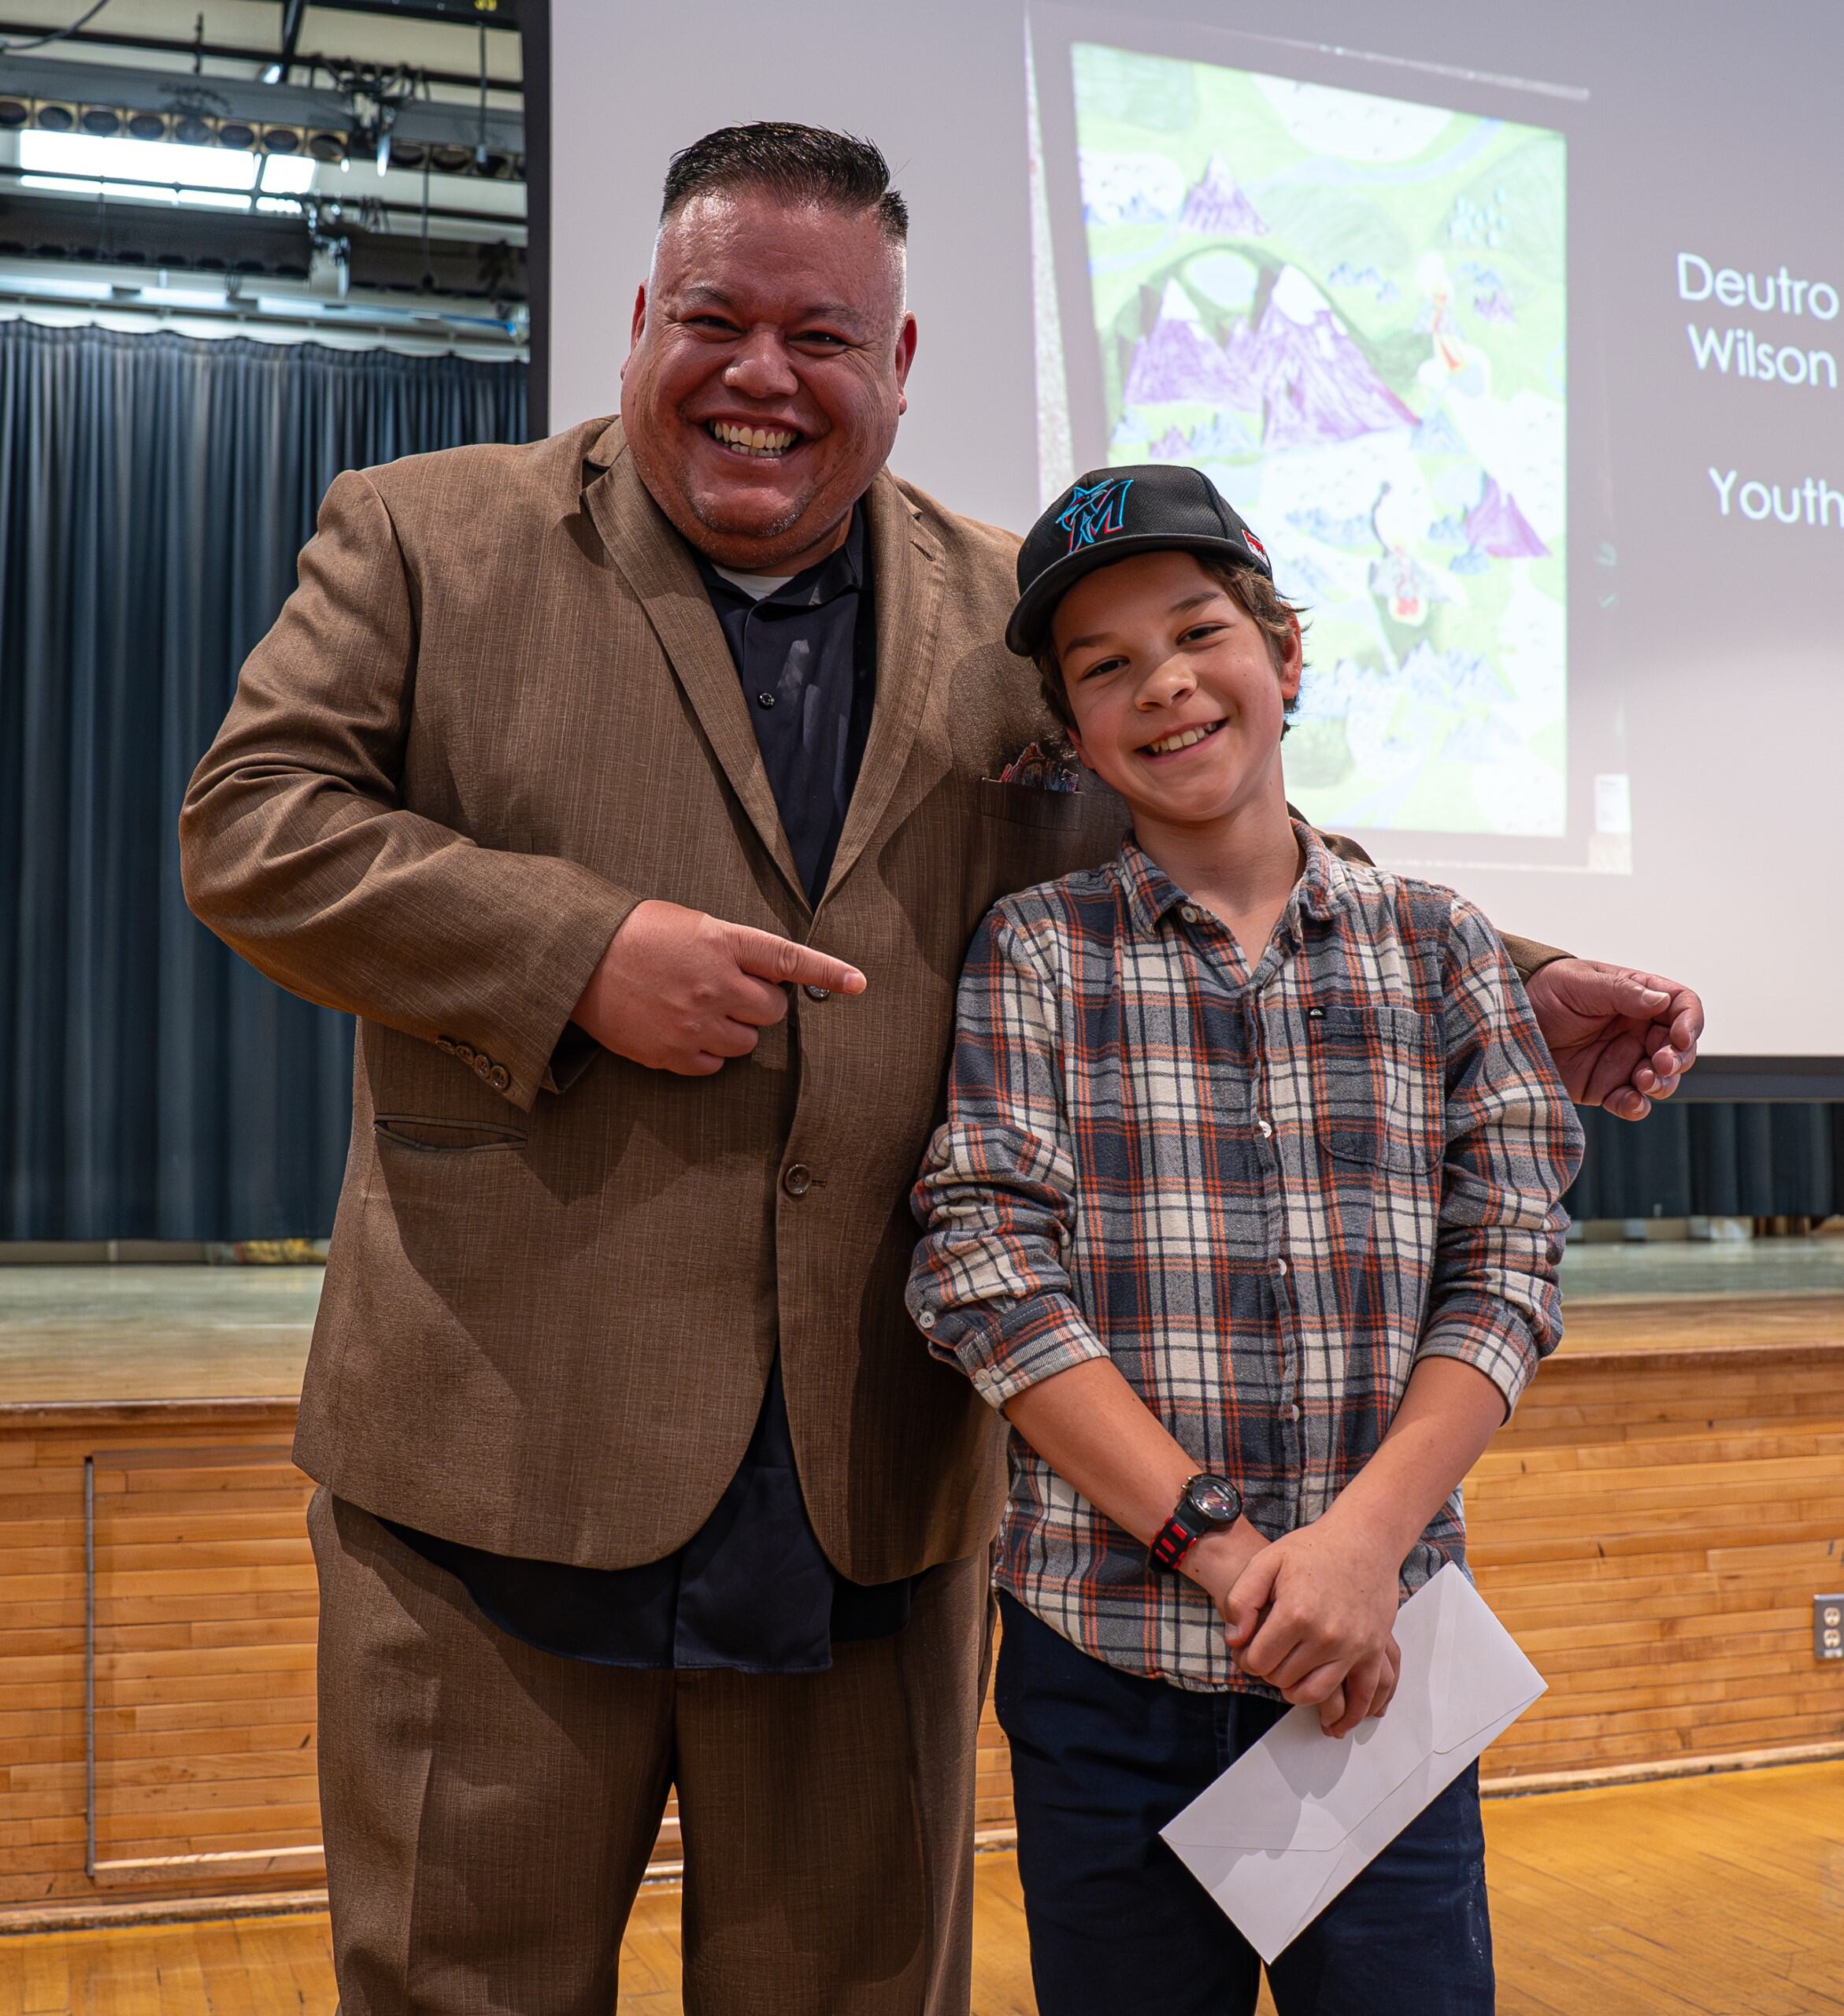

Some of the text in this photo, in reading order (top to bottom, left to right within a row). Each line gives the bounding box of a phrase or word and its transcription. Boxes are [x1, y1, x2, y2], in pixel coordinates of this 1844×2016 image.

[1677, 252, 1839, 320] Deutro
[1687, 323, 1838, 388] Wilson
[1056, 478, 1134, 555] M
[1709, 466, 1844, 528] Youth
